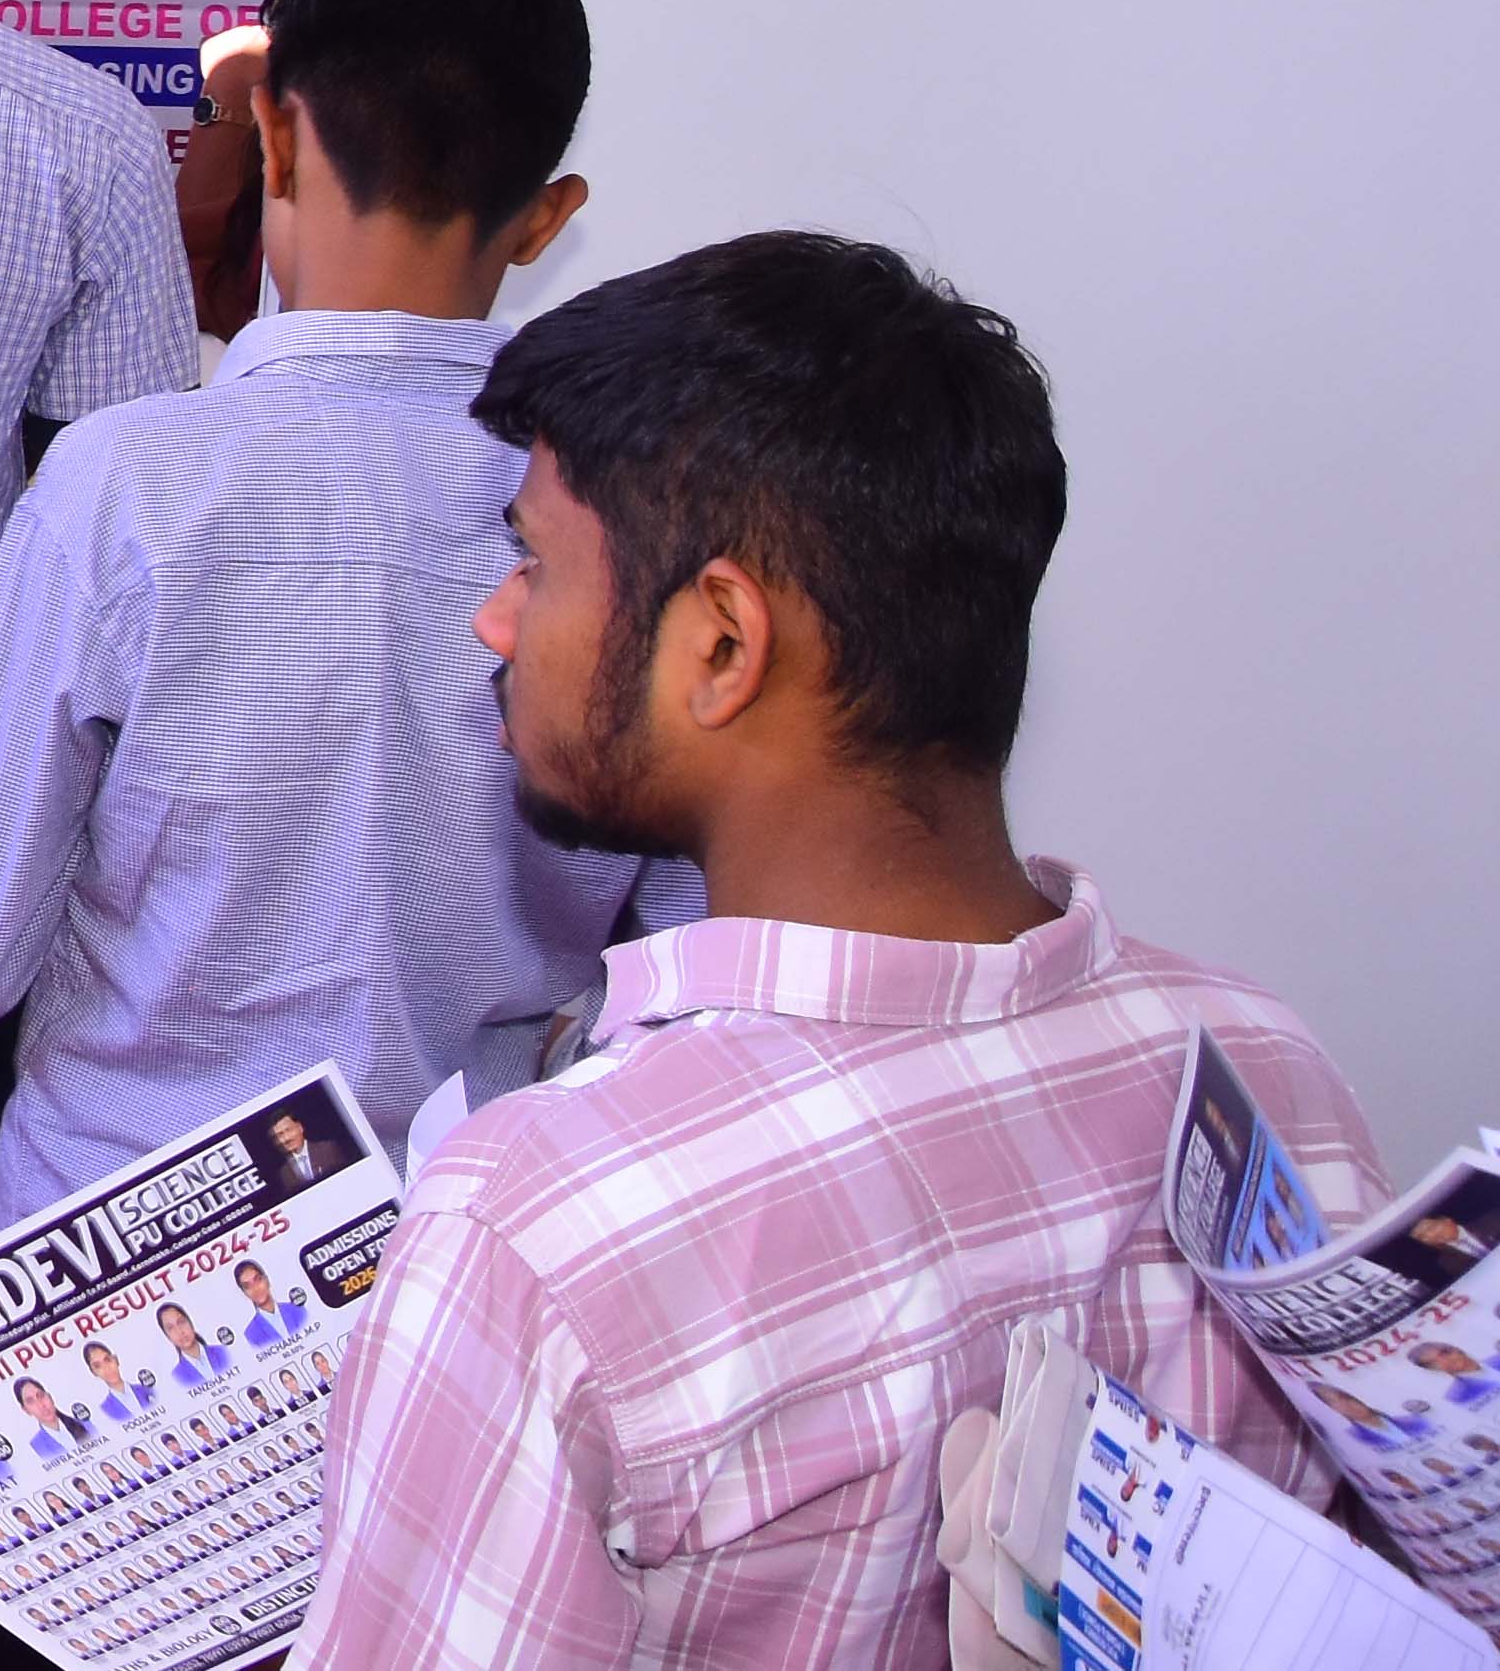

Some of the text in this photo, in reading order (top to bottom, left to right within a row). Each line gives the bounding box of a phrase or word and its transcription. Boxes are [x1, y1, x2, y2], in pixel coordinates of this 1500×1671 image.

[119, 1142, 244, 1223] SCIENCE
[126, 1169, 266, 1258] PU COLLEGE
[304, 1211, 398, 1270] ADMISSIONS
[323, 1252, 367, 1281] OPEN
[17, 1330, 75, 1369] PUC
[80, 1271, 178, 1340] RESULT
[179, 1210, 291, 1282] 2024-25
[1336, 1292, 1469, 1374] 2024-25
[163, 1628, 215, 1657] BIOLOGY
